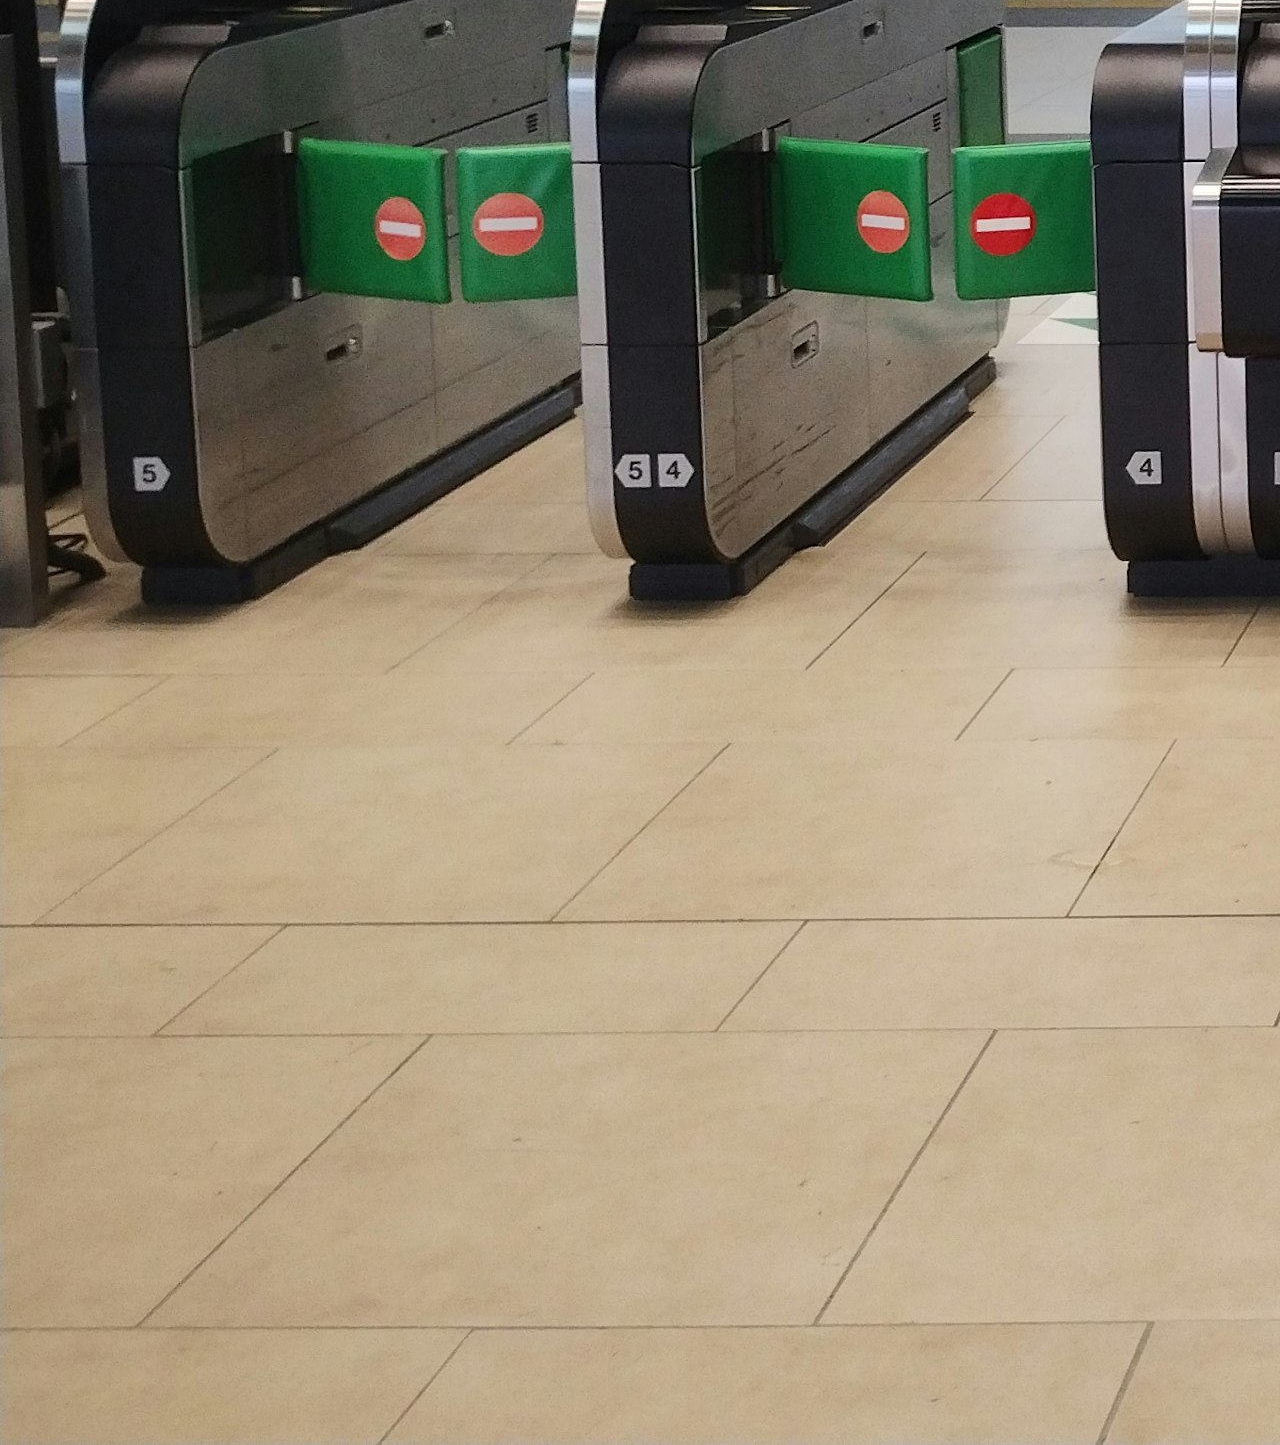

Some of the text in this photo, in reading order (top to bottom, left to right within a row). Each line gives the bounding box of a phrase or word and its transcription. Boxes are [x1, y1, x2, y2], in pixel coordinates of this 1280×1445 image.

[141, 463, 158, 484] 5
[627, 460, 643, 481] 5
[665, 460, 681, 480] 4
[1138, 458, 1155, 477] 4
